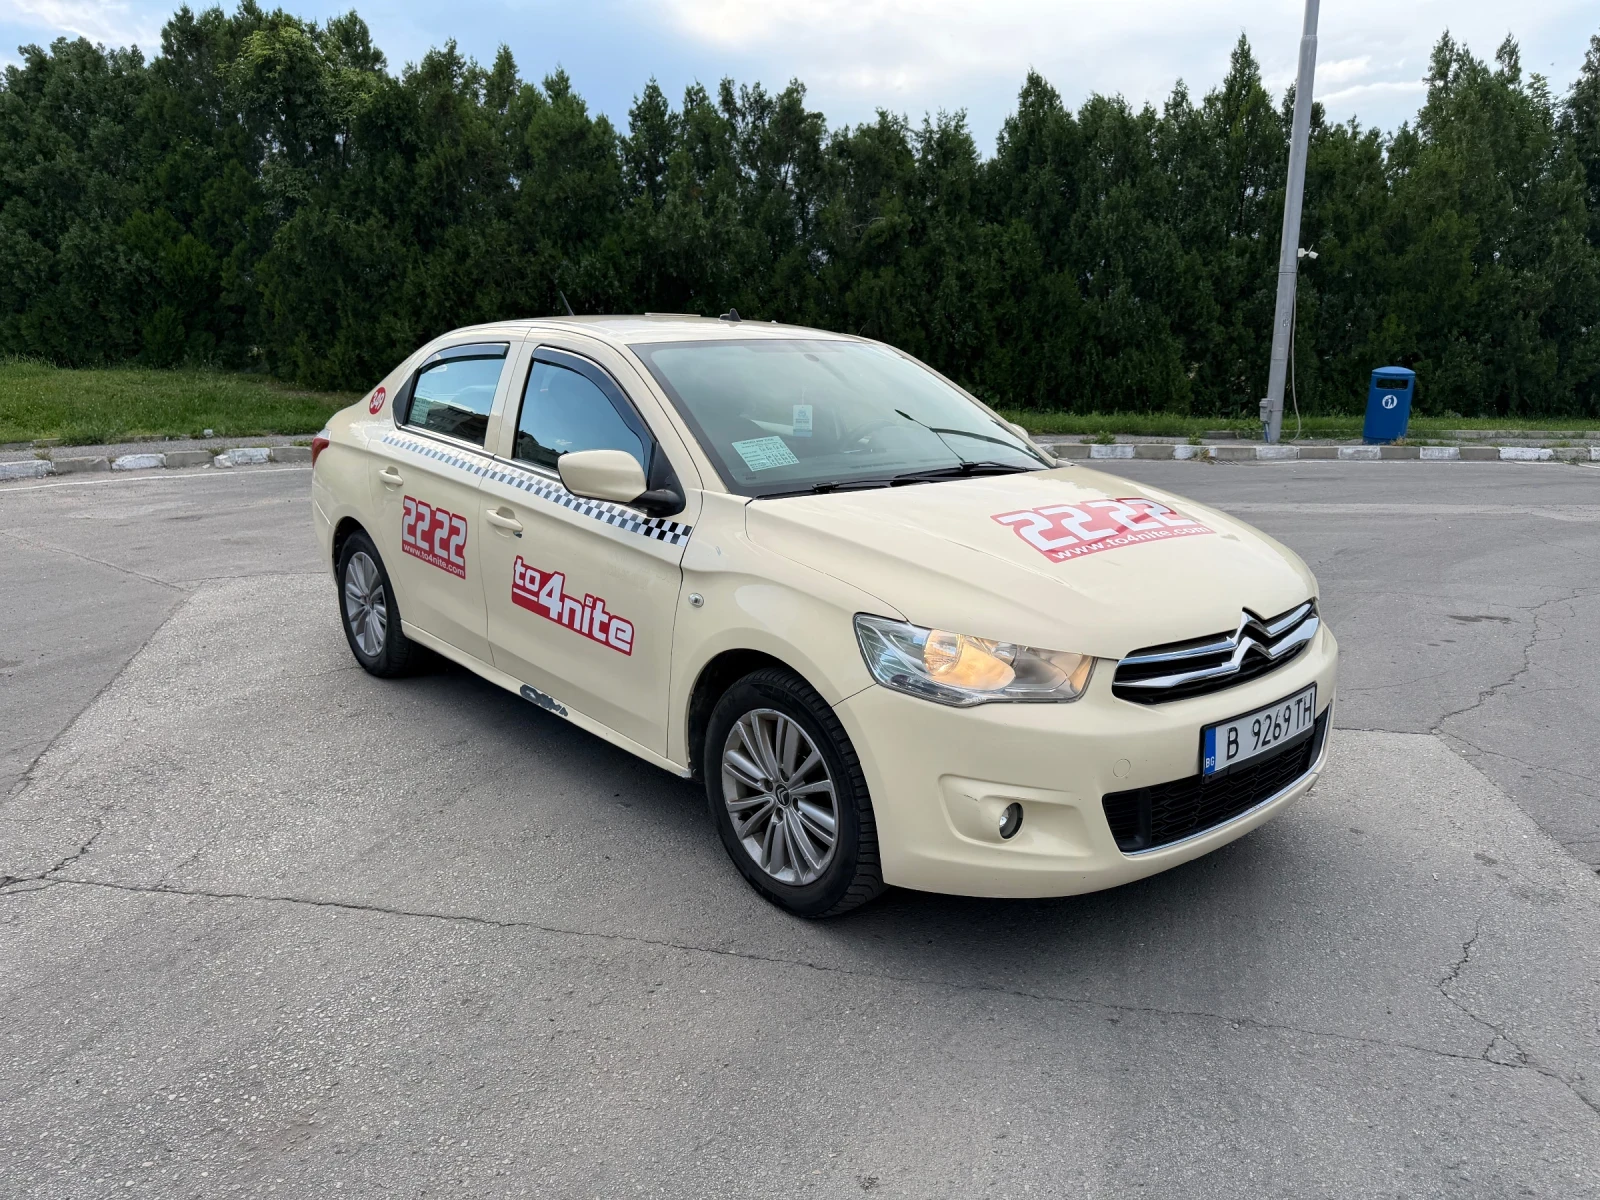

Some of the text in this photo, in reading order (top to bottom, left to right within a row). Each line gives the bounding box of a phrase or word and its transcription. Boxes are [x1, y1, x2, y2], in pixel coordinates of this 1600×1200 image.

[1051, 525, 1211, 559] www.to4nite.com
[403, 543, 465, 577] www.to4nite.com
[515, 558, 633, 653] to4nite
[1226, 692, 1314, 761] B 9269 TH
[1205, 756, 1215, 768] BG
